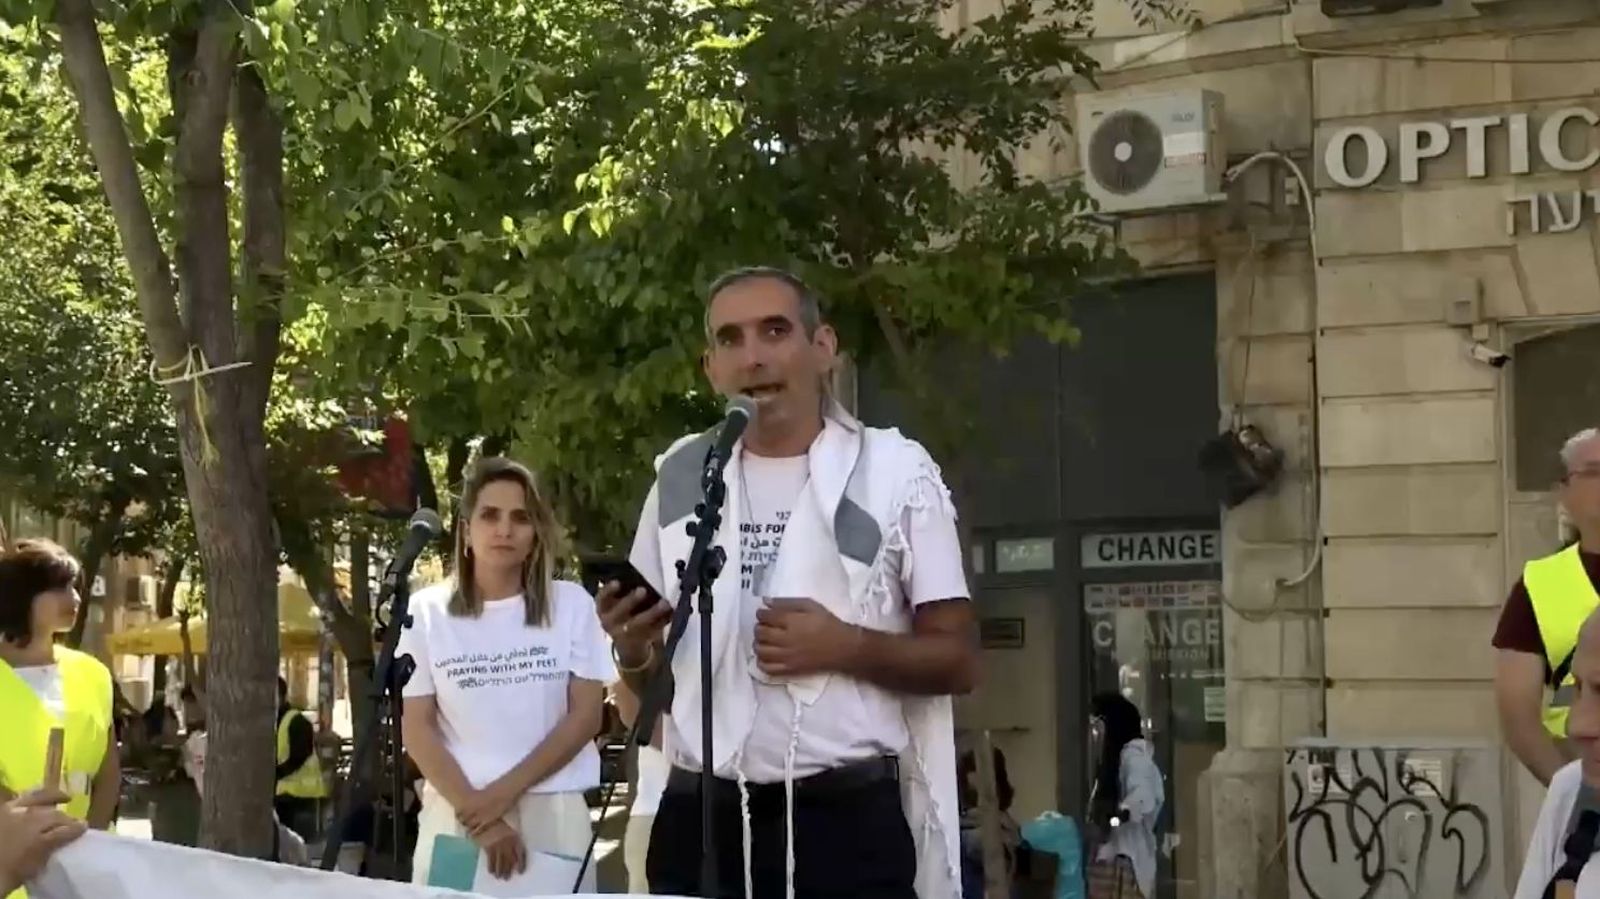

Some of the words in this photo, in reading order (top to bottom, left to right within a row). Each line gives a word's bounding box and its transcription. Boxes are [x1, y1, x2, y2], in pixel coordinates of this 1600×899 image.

[1325, 107, 1600, 188] OPTIC
[1097, 533, 1215, 562] CHANGE
[447, 665, 487, 678] PRAYING
[490, 663, 517, 673] WITH
[519, 661, 533, 670] MY
[536, 658, 557, 668] FEET
